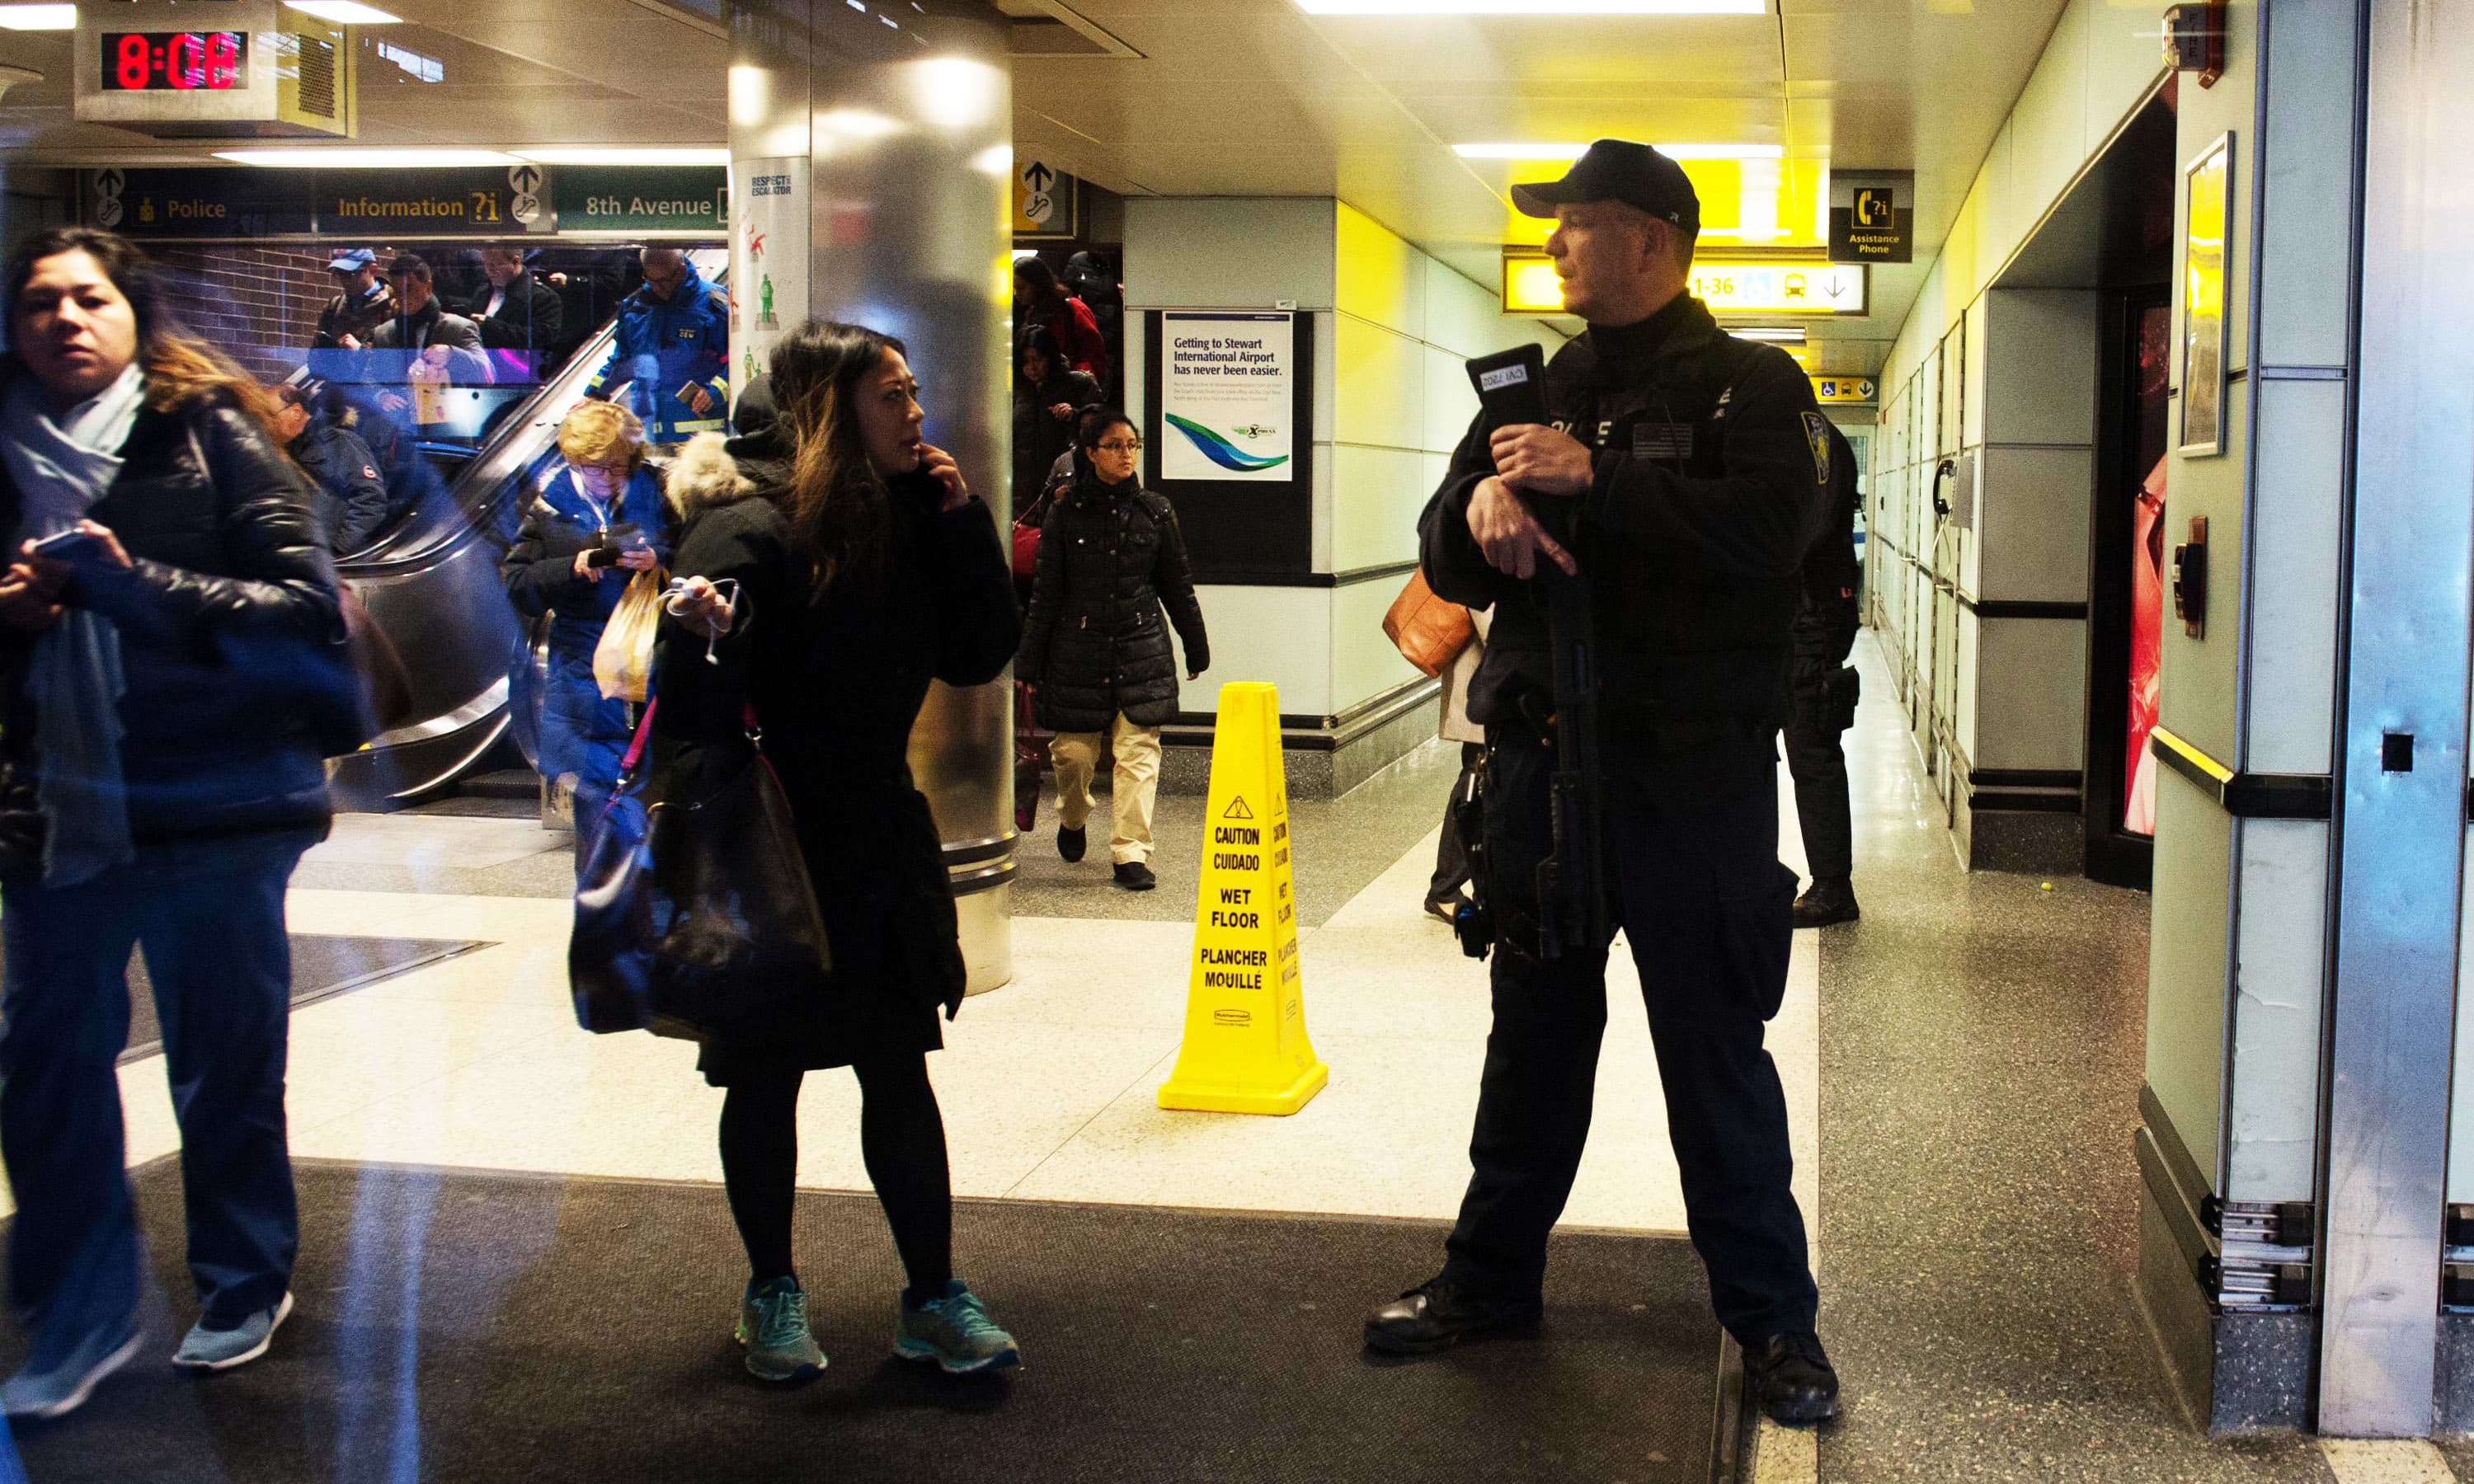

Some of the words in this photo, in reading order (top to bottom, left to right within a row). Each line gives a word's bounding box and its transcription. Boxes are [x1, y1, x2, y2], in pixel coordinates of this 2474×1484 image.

[117, 34, 236, 90] 8:08
[167, 198, 226, 218] Police
[338, 197, 464, 218] Information
[586, 196, 622, 216] 8th
[629, 197, 713, 216] Avenue
[1849, 234, 1900, 243] Assistance
[1859, 244, 1889, 254] Phone
[1693, 278, 1733, 295] 1-36
[1174, 337, 1210, 350] Getting
[1212, 338, 1222, 349] to
[1225, 338, 1263, 350] Stewart
[1174, 351, 1236, 362] International
[1239, 352, 1275, 364] Airport
[1174, 364, 1191, 375] has
[1193, 366, 1221, 375] never
[1224, 364, 1248, 376] been
[1250, 365, 1282, 376] easier.
[1215, 826, 1260, 845] CAUTION
[1214, 852, 1259, 871] CUIDADO
[1221, 888, 1251, 905] WET
[1211, 911, 1259, 929] FLOOR
[1201, 948, 1268, 966] PLANCHER
[1205, 970, 1262, 990] MOUILLÉ
